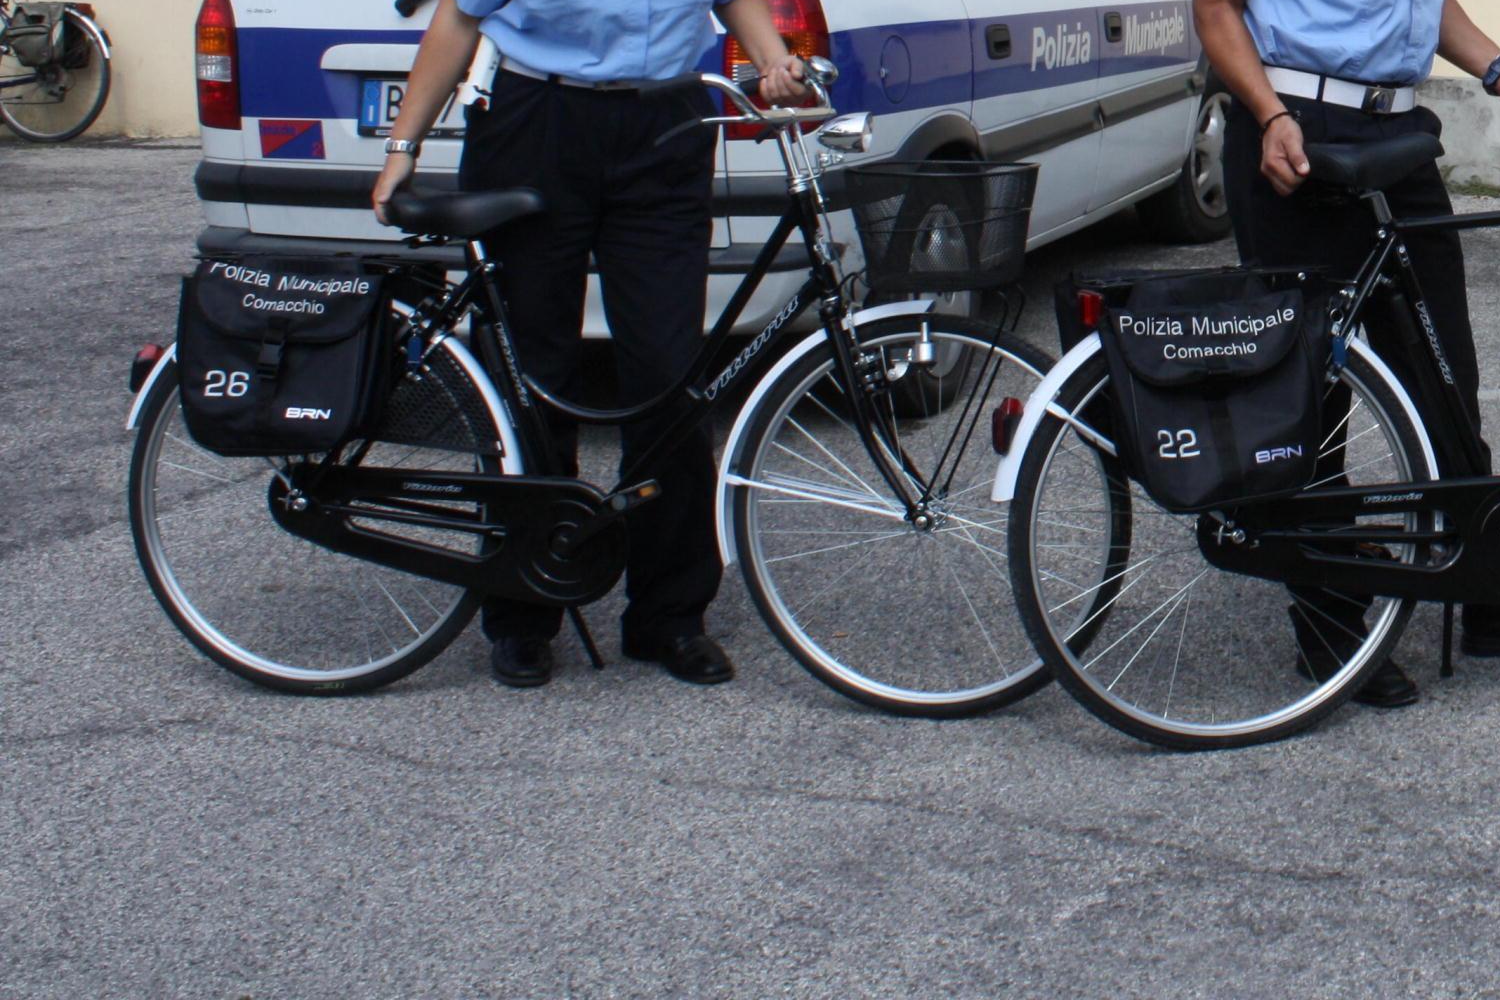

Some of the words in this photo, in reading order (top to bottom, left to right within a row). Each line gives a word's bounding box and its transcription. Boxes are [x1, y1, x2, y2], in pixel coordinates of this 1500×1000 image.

[1031, 22, 1092, 72] Polizia
[1125, 7, 1185, 55] Municipale
[210, 262, 271, 287] Polizia
[278, 275, 369, 296] Municipale
[243, 293, 325, 314] Comacchio
[1119, 315, 1184, 336] Polizia
[1192, 307, 1295, 336] Municipale
[1163, 342, 1257, 359] Comacchio
[204, 370, 250, 397] 26
[285, 407, 331, 419] BRN
[1157, 429, 1200, 458] 22
[1255, 445, 1303, 464] BRN
